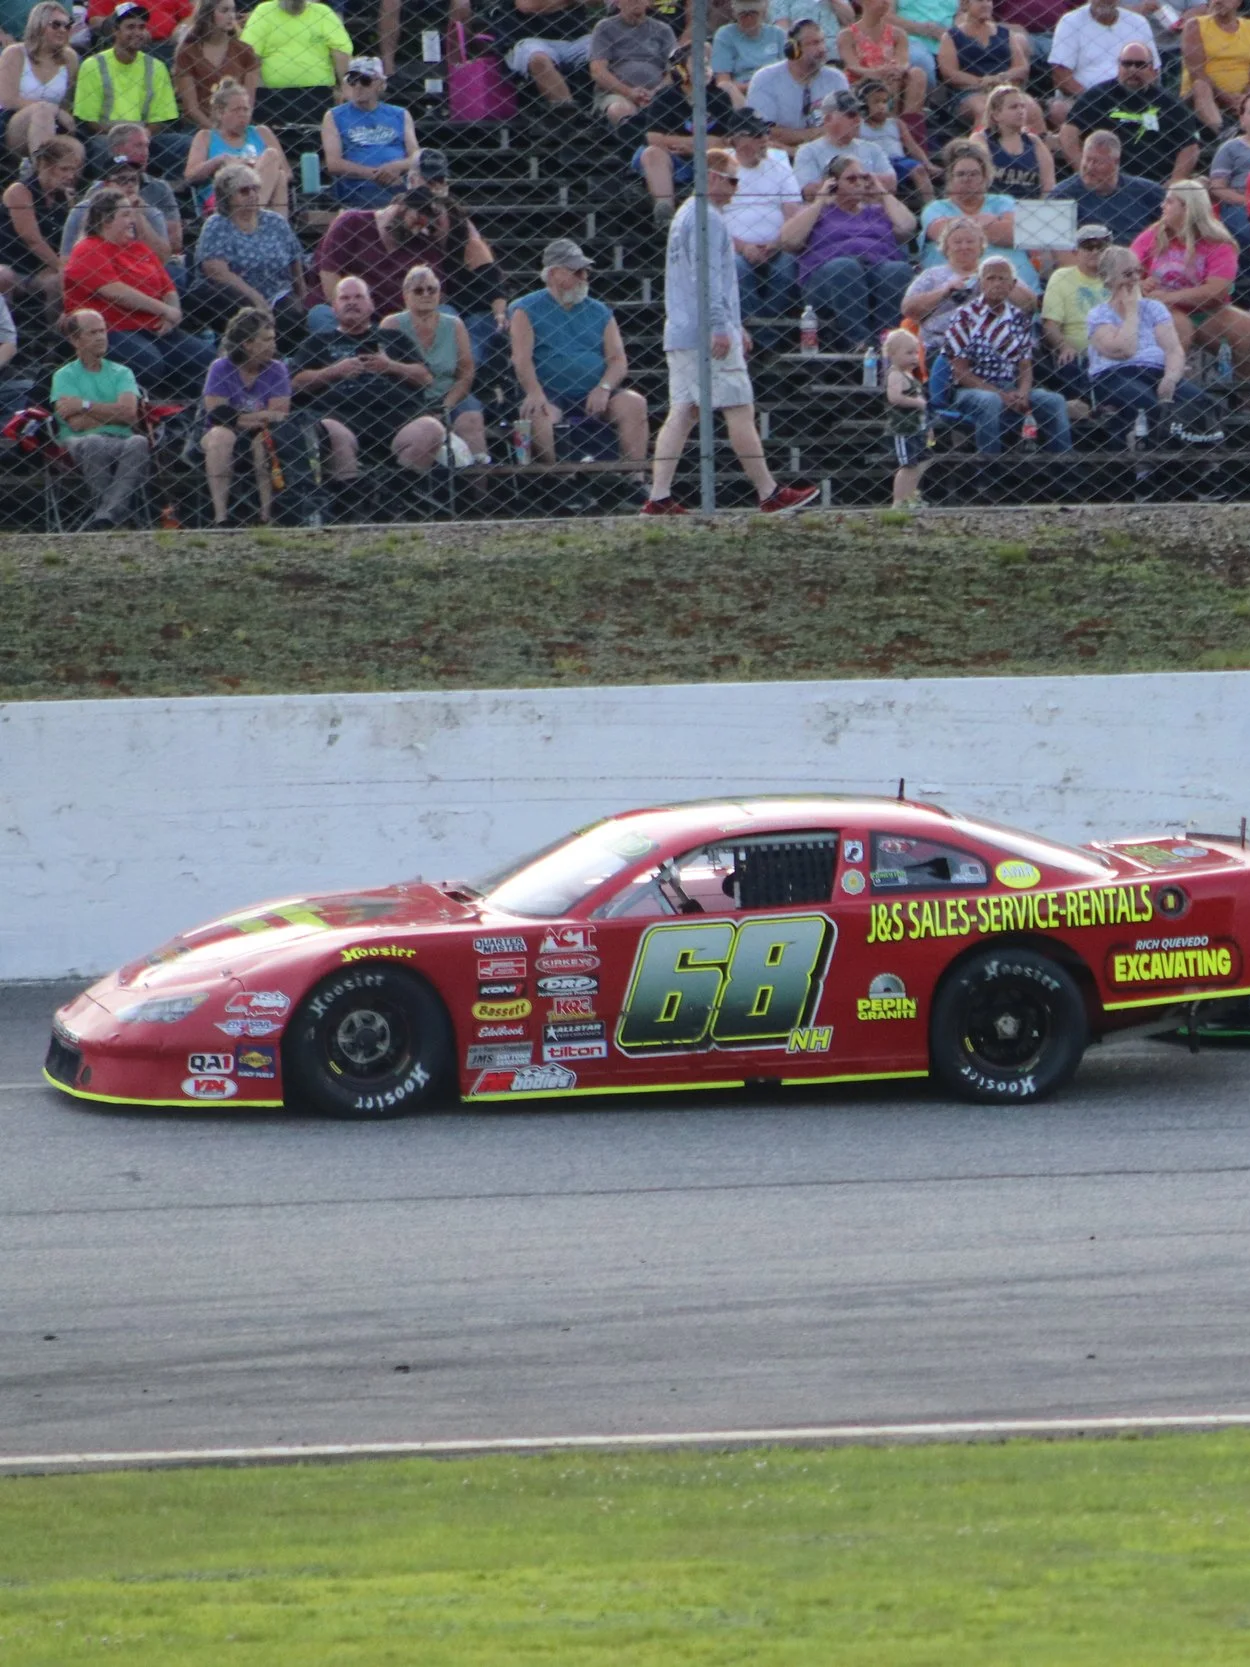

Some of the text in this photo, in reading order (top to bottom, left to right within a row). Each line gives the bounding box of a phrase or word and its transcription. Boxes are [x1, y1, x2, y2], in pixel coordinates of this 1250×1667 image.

[867, 901, 904, 943] J&S
[474, 936, 523, 950] QUARTER
[483, 943, 526, 954] MASTER
[1135, 935, 1209, 950] RICH QUEVEDO
[340, 945, 417, 963] Hoosier
[1113, 948, 1233, 983] EXCAVATING
[614, 912, 838, 1058] 68
[309, 973, 385, 1019] Hoosier
[479, 1002, 526, 1017] Bassett
[857, 998, 916, 1012] PEPIN
[857, 1009, 917, 1020] GRANITE
[556, 1024, 602, 1033] ALLSTAR
[787, 1027, 834, 1053] NH
[547, 1046, 603, 1059] tilton
[190, 1055, 231, 1072] QA1
[355, 1062, 431, 1112] Hoosier
[960, 1066, 1037, 1096] Hoosier
